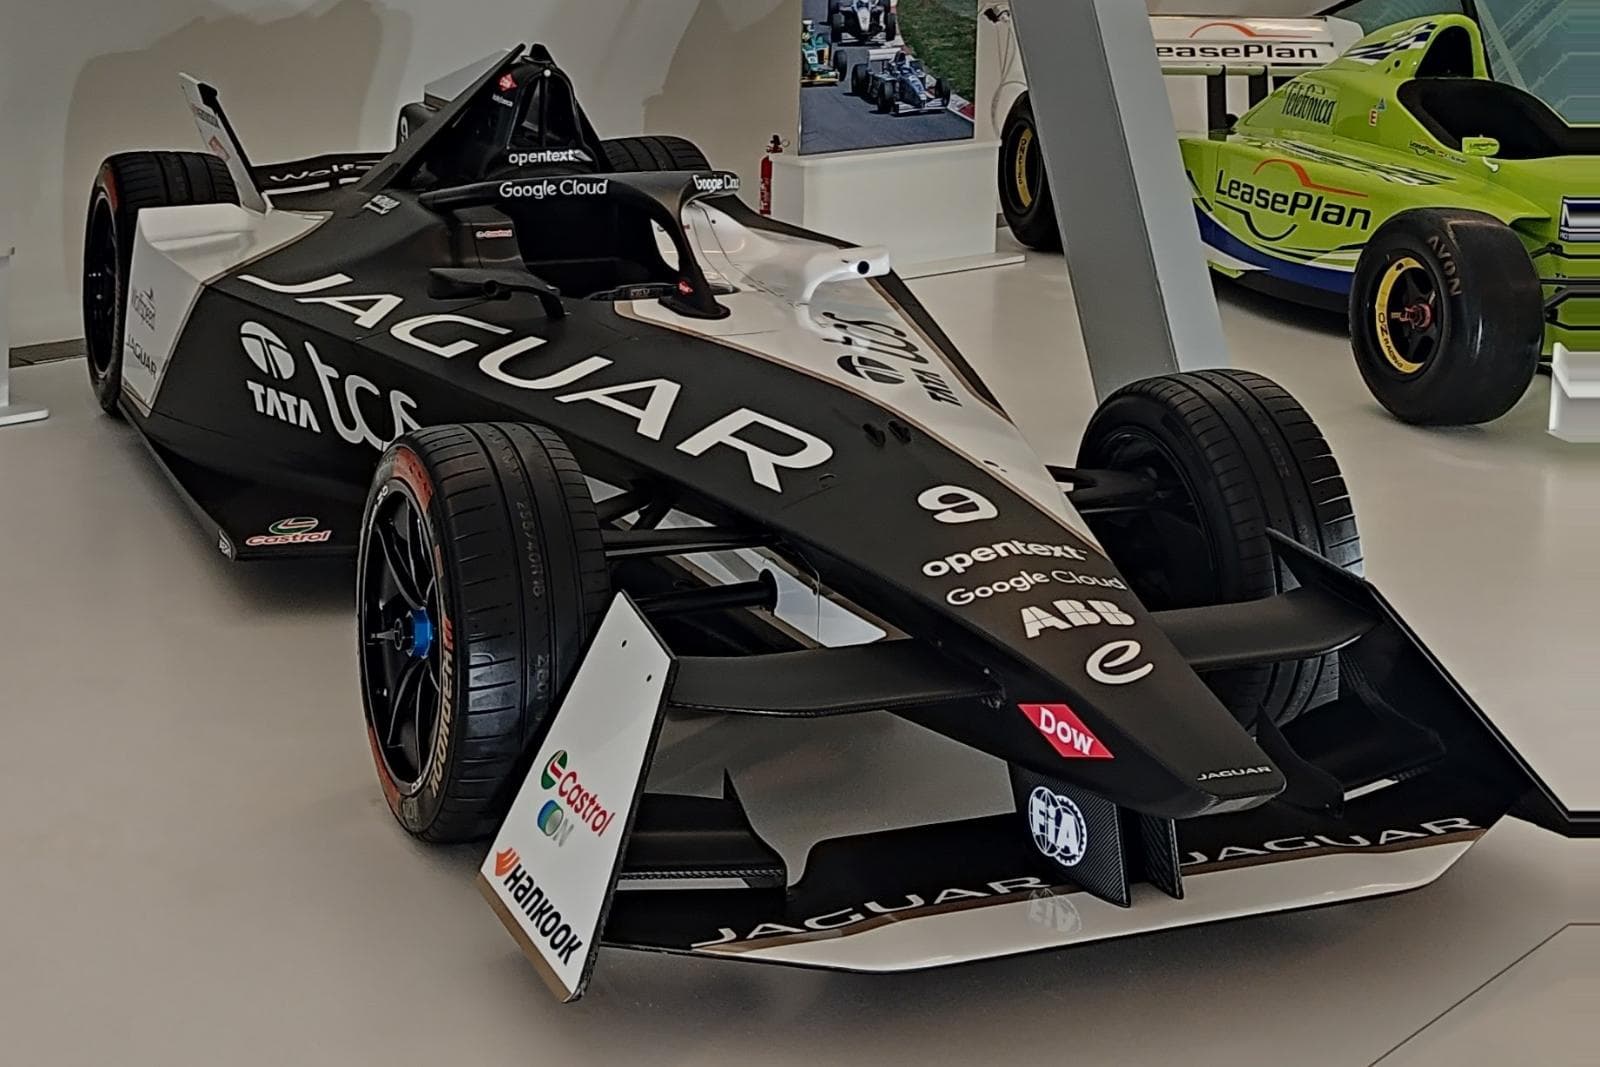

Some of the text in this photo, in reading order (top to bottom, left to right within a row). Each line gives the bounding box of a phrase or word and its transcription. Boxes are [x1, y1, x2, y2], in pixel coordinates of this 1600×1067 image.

[1155, 44, 1318, 59] easePlan
[500, 179, 609, 199] Google Cloud
[1215, 169, 1371, 231] LeasePlan
[1428, 235, 1464, 296] AVON
[238, 273, 834, 493] JAGUAR
[246, 380, 321, 433] TATA
[917, 485, 998, 523] 9
[246, 530, 331, 546] Castrol
[922, 540, 1087, 577] opentext
[946, 570, 1127, 605] Google Cloud
[1020, 600, 1135, 639] ABB
[1197, 766, 1272, 781] JAGUAR
[558, 771, 616, 837] Castrol
[1180, 816, 1480, 866] JAGUAR
[691, 875, 1050, 948] JAGUAR
